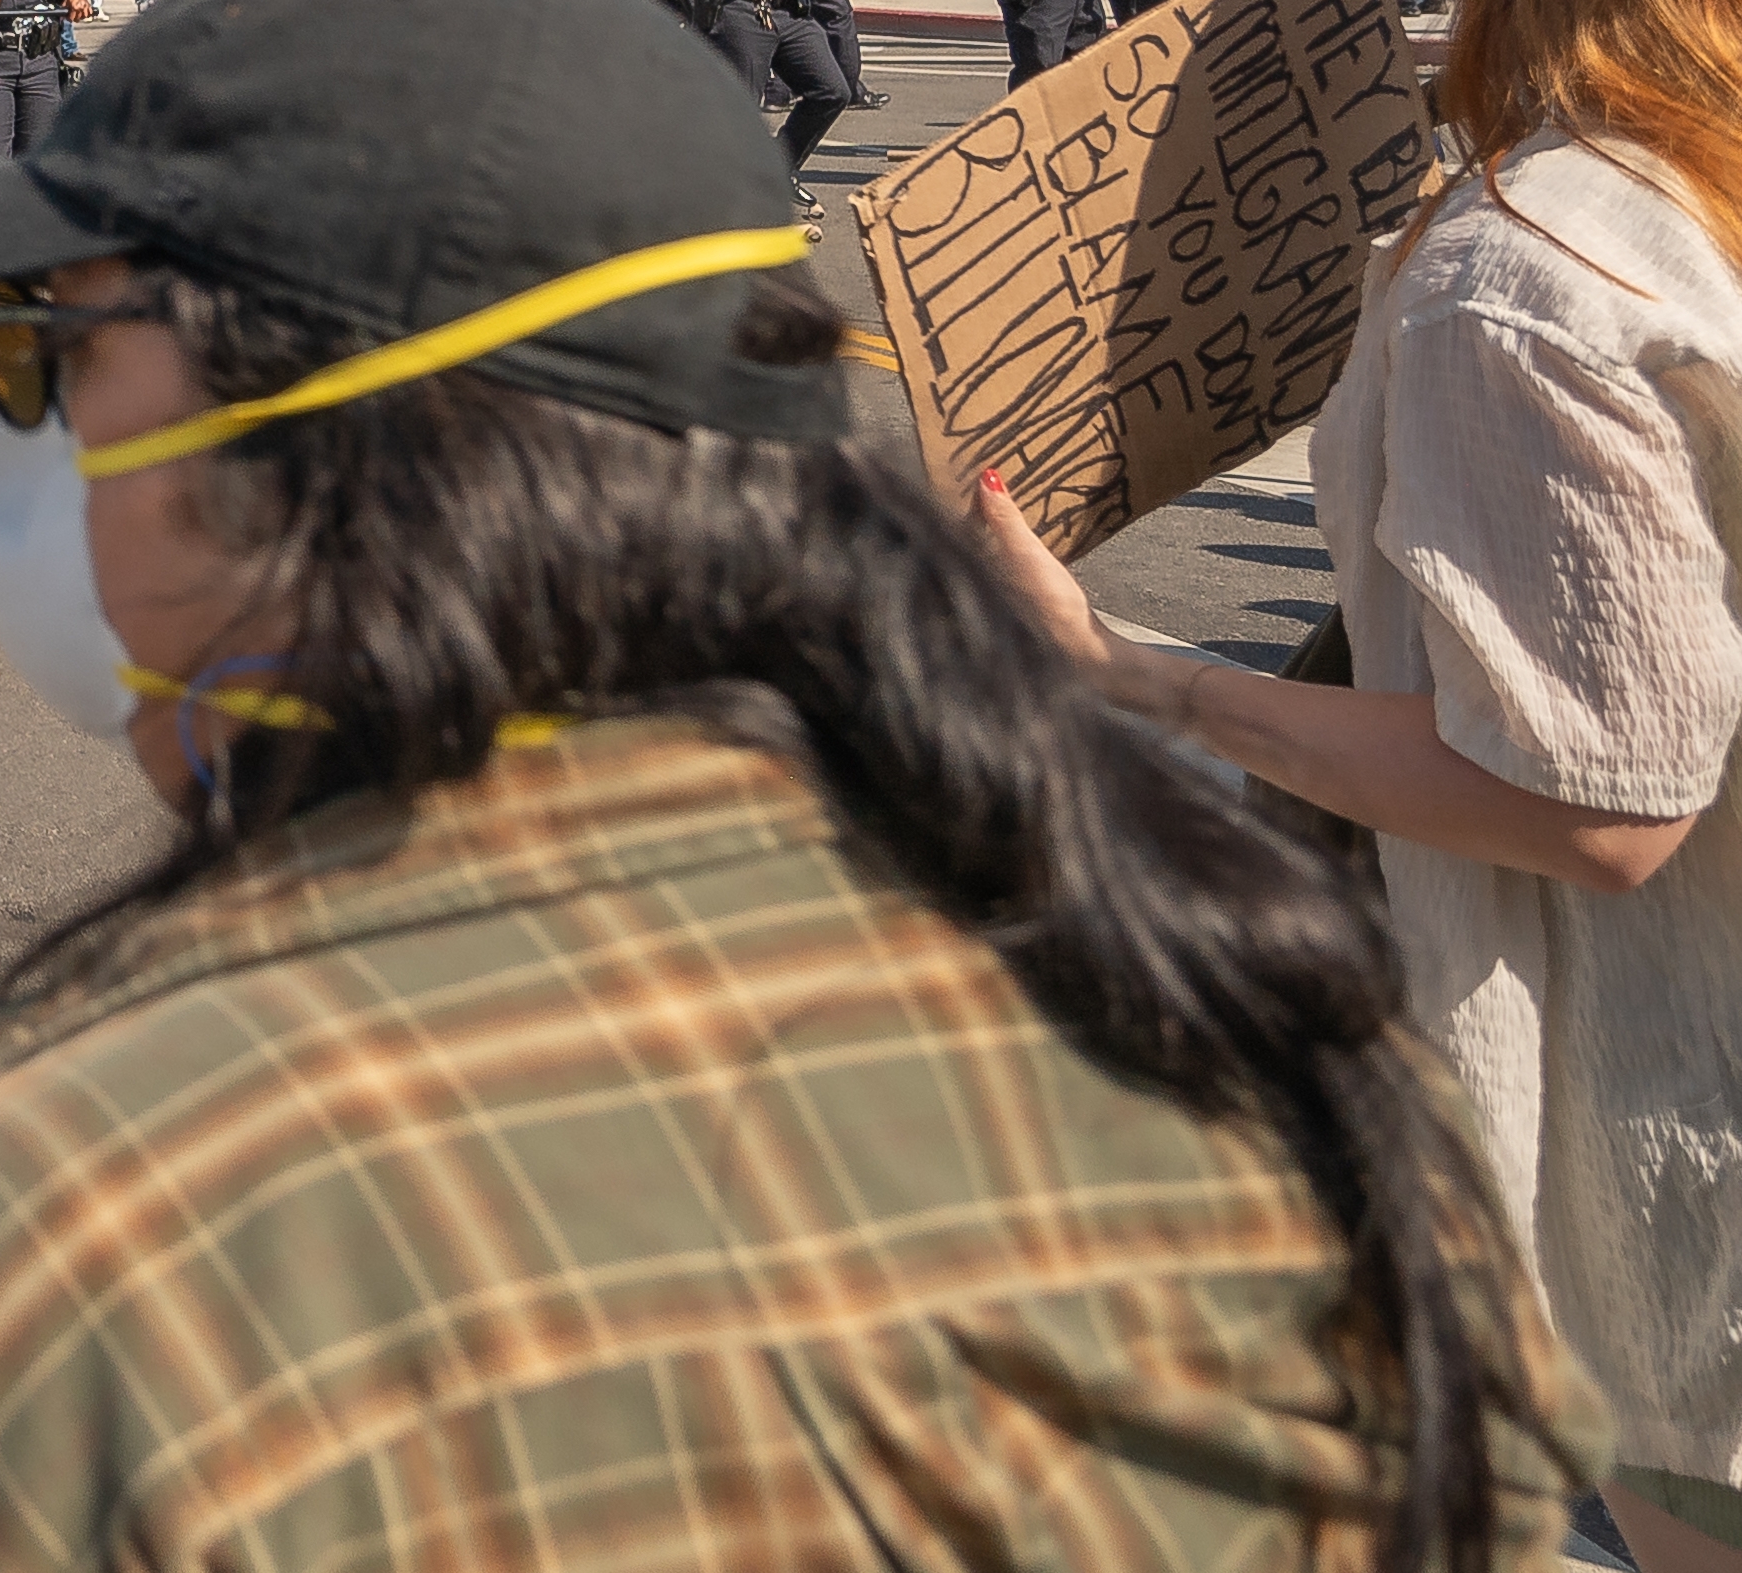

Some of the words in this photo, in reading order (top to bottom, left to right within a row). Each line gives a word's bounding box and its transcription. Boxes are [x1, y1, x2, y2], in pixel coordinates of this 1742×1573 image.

[1044, 112, 1194, 436] BLAME
[1104, 34, 1180, 139] SO
[1148, 166, 1228, 306] YOU
